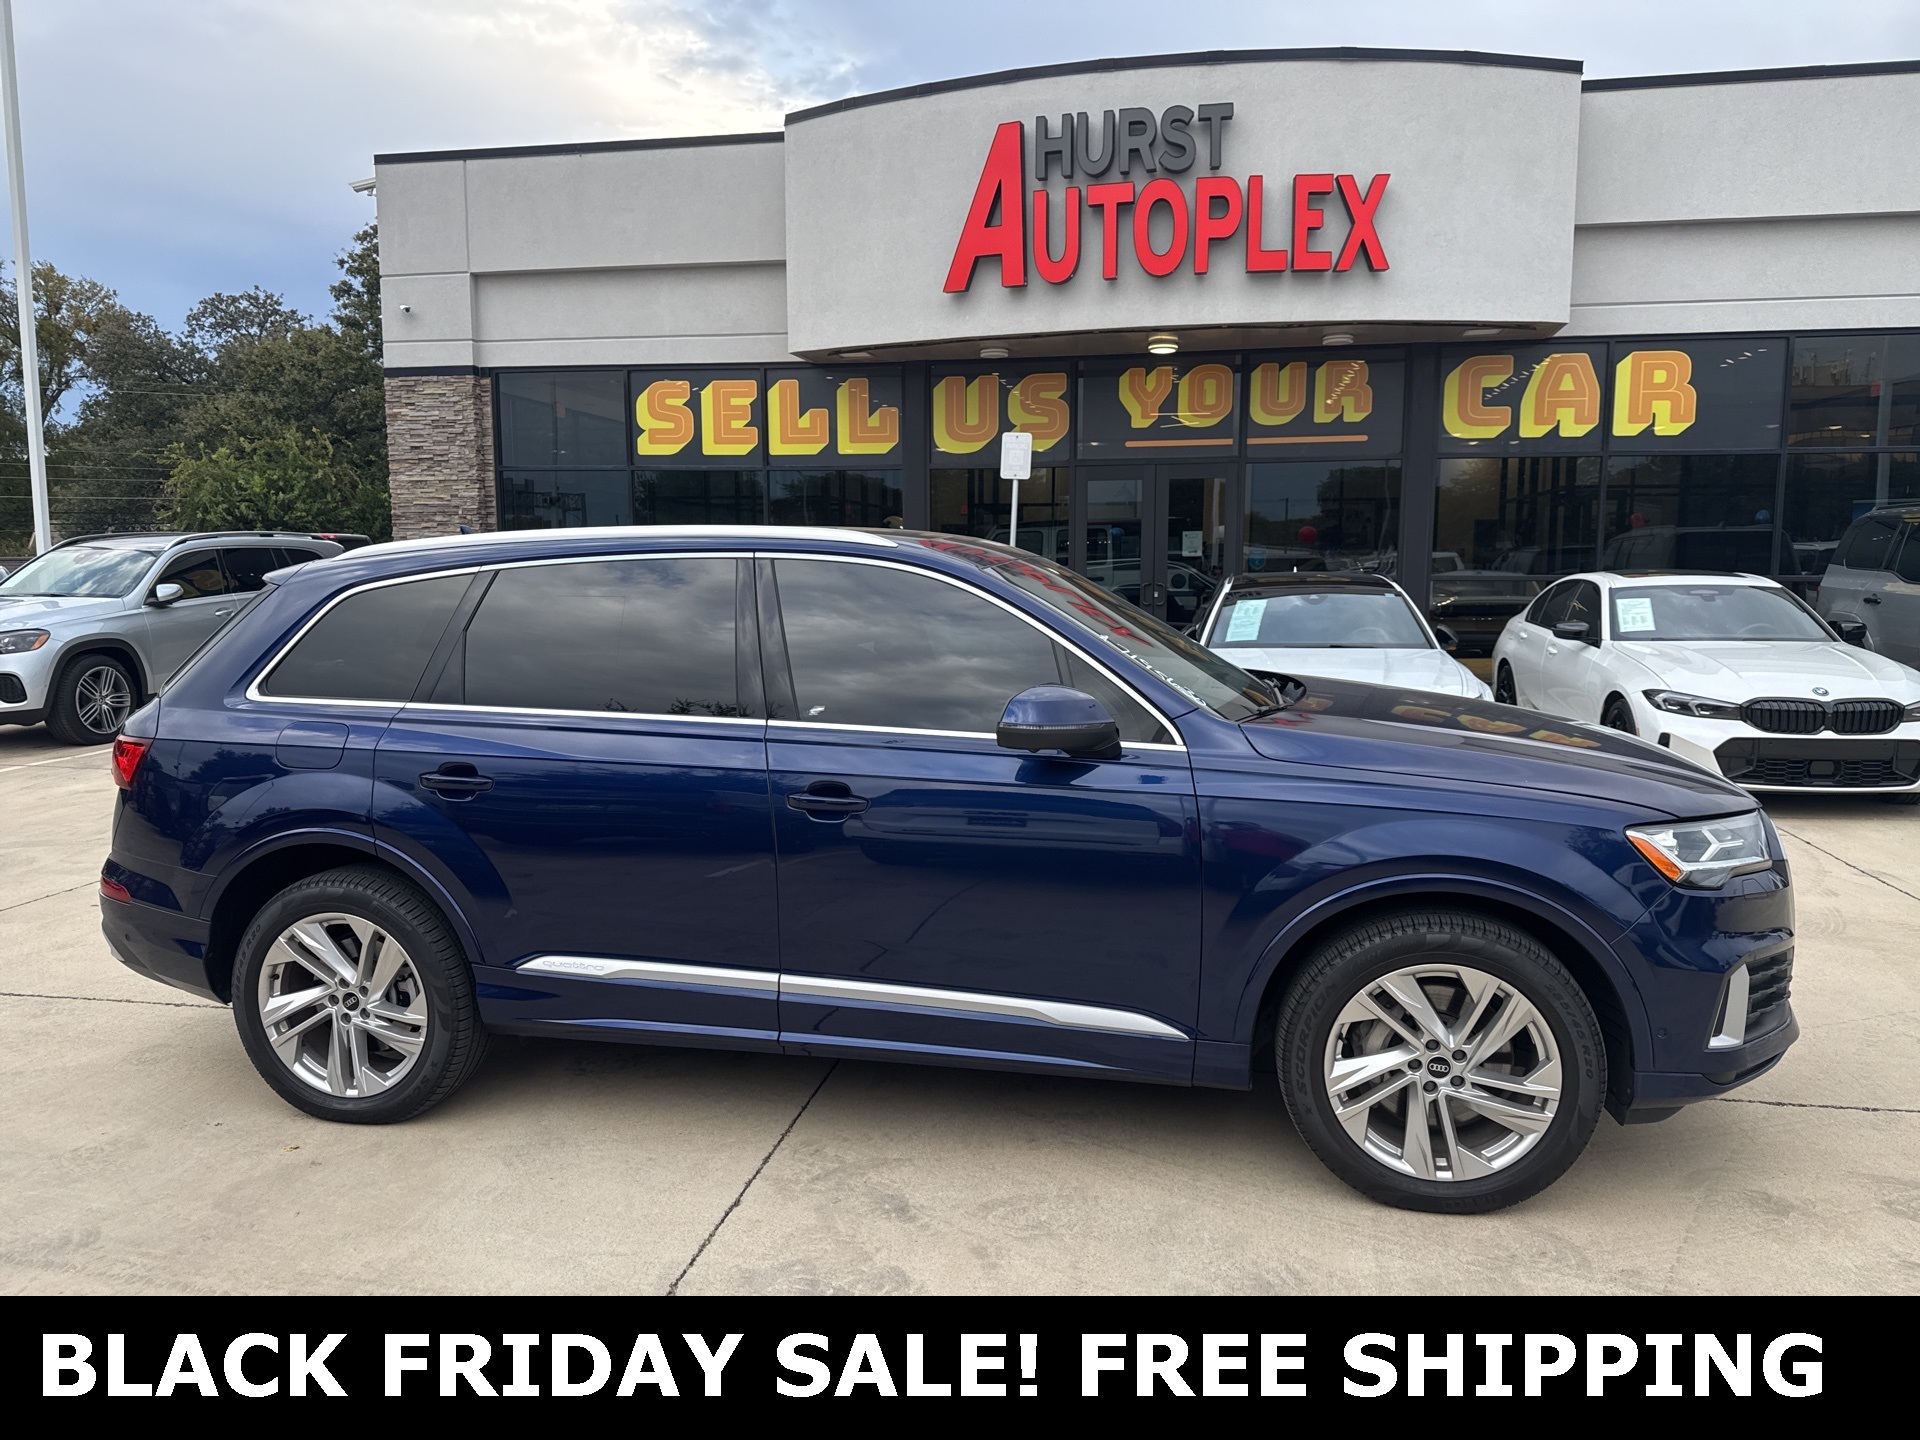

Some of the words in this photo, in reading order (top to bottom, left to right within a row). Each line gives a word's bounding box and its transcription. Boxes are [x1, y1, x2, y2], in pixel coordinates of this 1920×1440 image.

[1035, 102, 1235, 181] HURST
[943, 120, 1391, 293] AUTOPLEX
[636, 378, 900, 456] SELL
[933, 372, 1070, 454] US
[1118, 360, 1373, 429] YOUR
[1442, 350, 1697, 439] CAR
[542, 960, 605, 971] quattro
[1296, 980, 1339, 1097] SCORPION
